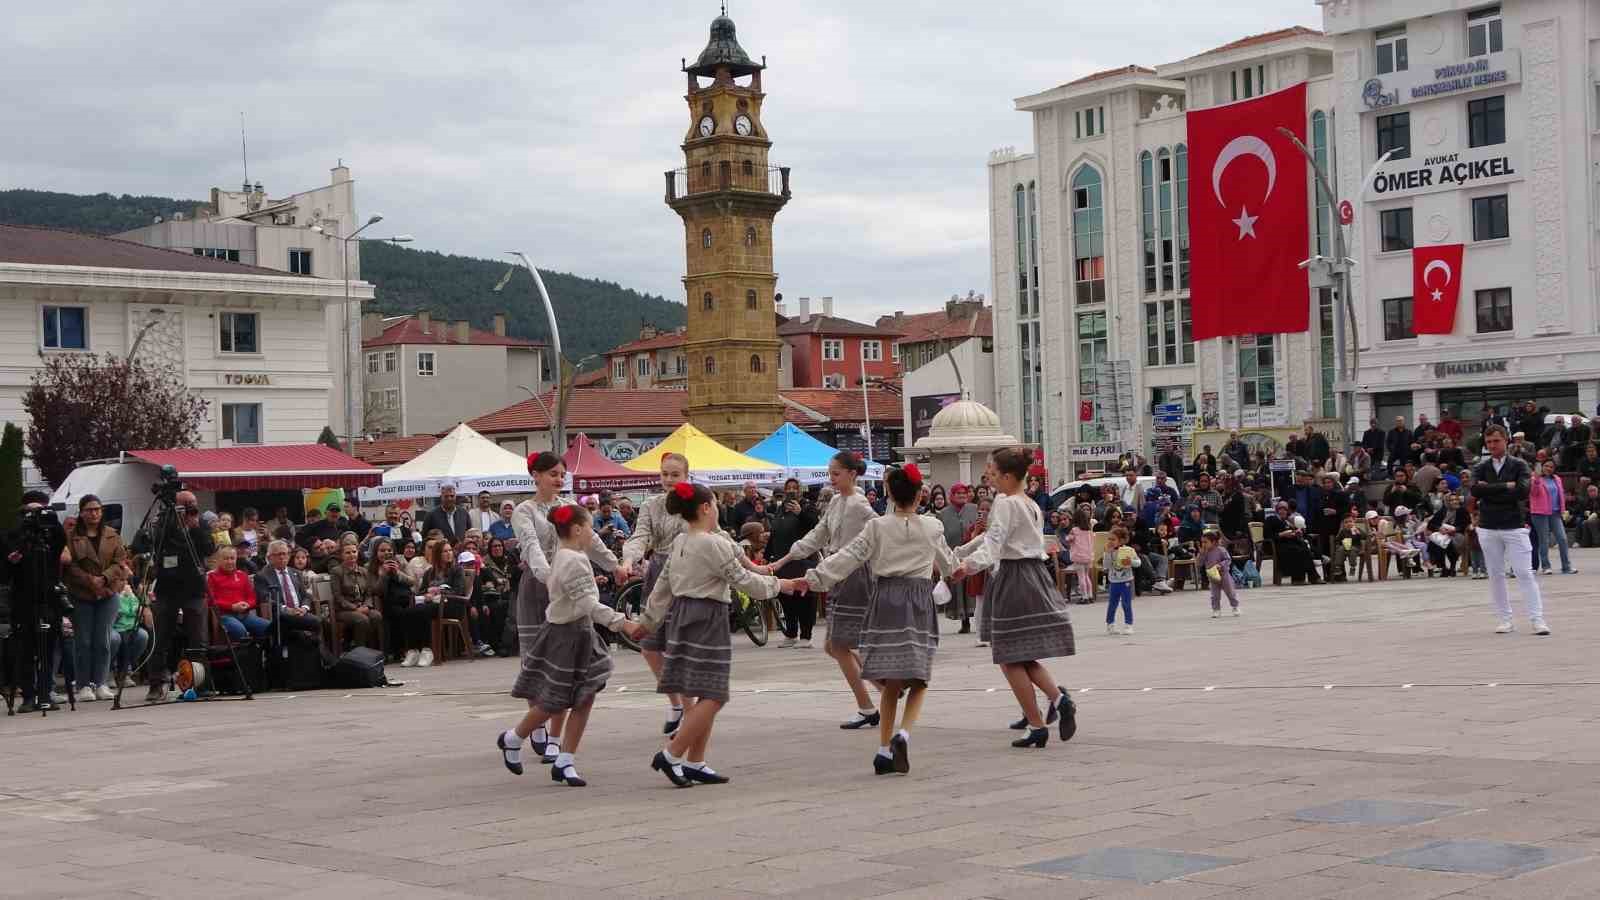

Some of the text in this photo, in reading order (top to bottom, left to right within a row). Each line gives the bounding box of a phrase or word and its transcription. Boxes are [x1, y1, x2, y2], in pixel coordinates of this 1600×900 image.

[1424, 153, 1459, 167] AVUKAT
[1373, 157, 1514, 193] ÖMER AÇIKEL
[1446, 361, 1506, 375] HALKBANK
[506, 478, 535, 486] BELEDİY
